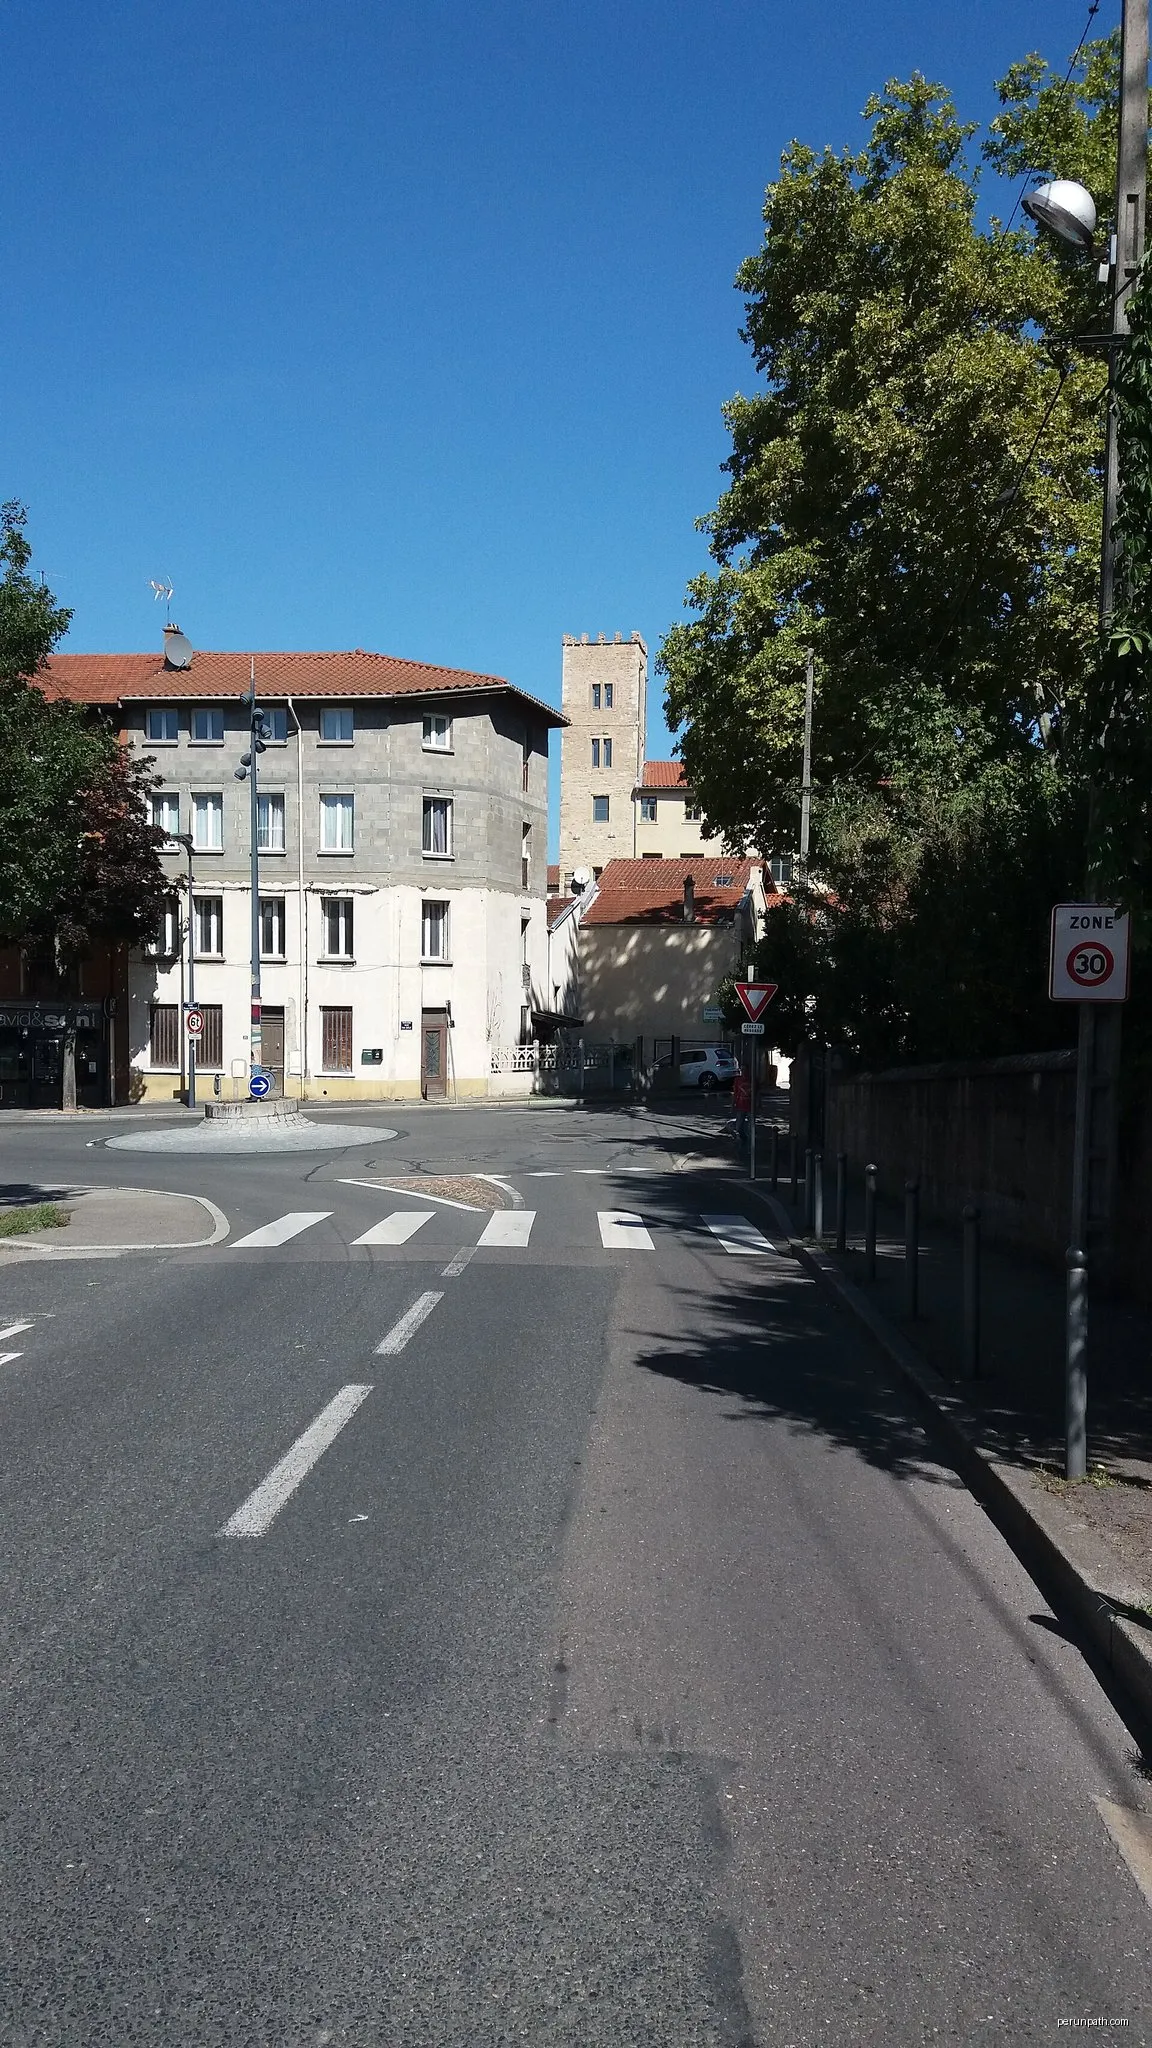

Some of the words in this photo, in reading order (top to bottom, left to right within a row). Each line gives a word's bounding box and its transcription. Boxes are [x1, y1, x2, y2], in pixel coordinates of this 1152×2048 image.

[1070, 916, 1114, 930] ZONE
[1075, 954, 1105, 975] 30
[190, 1017, 200, 1028] 6t
